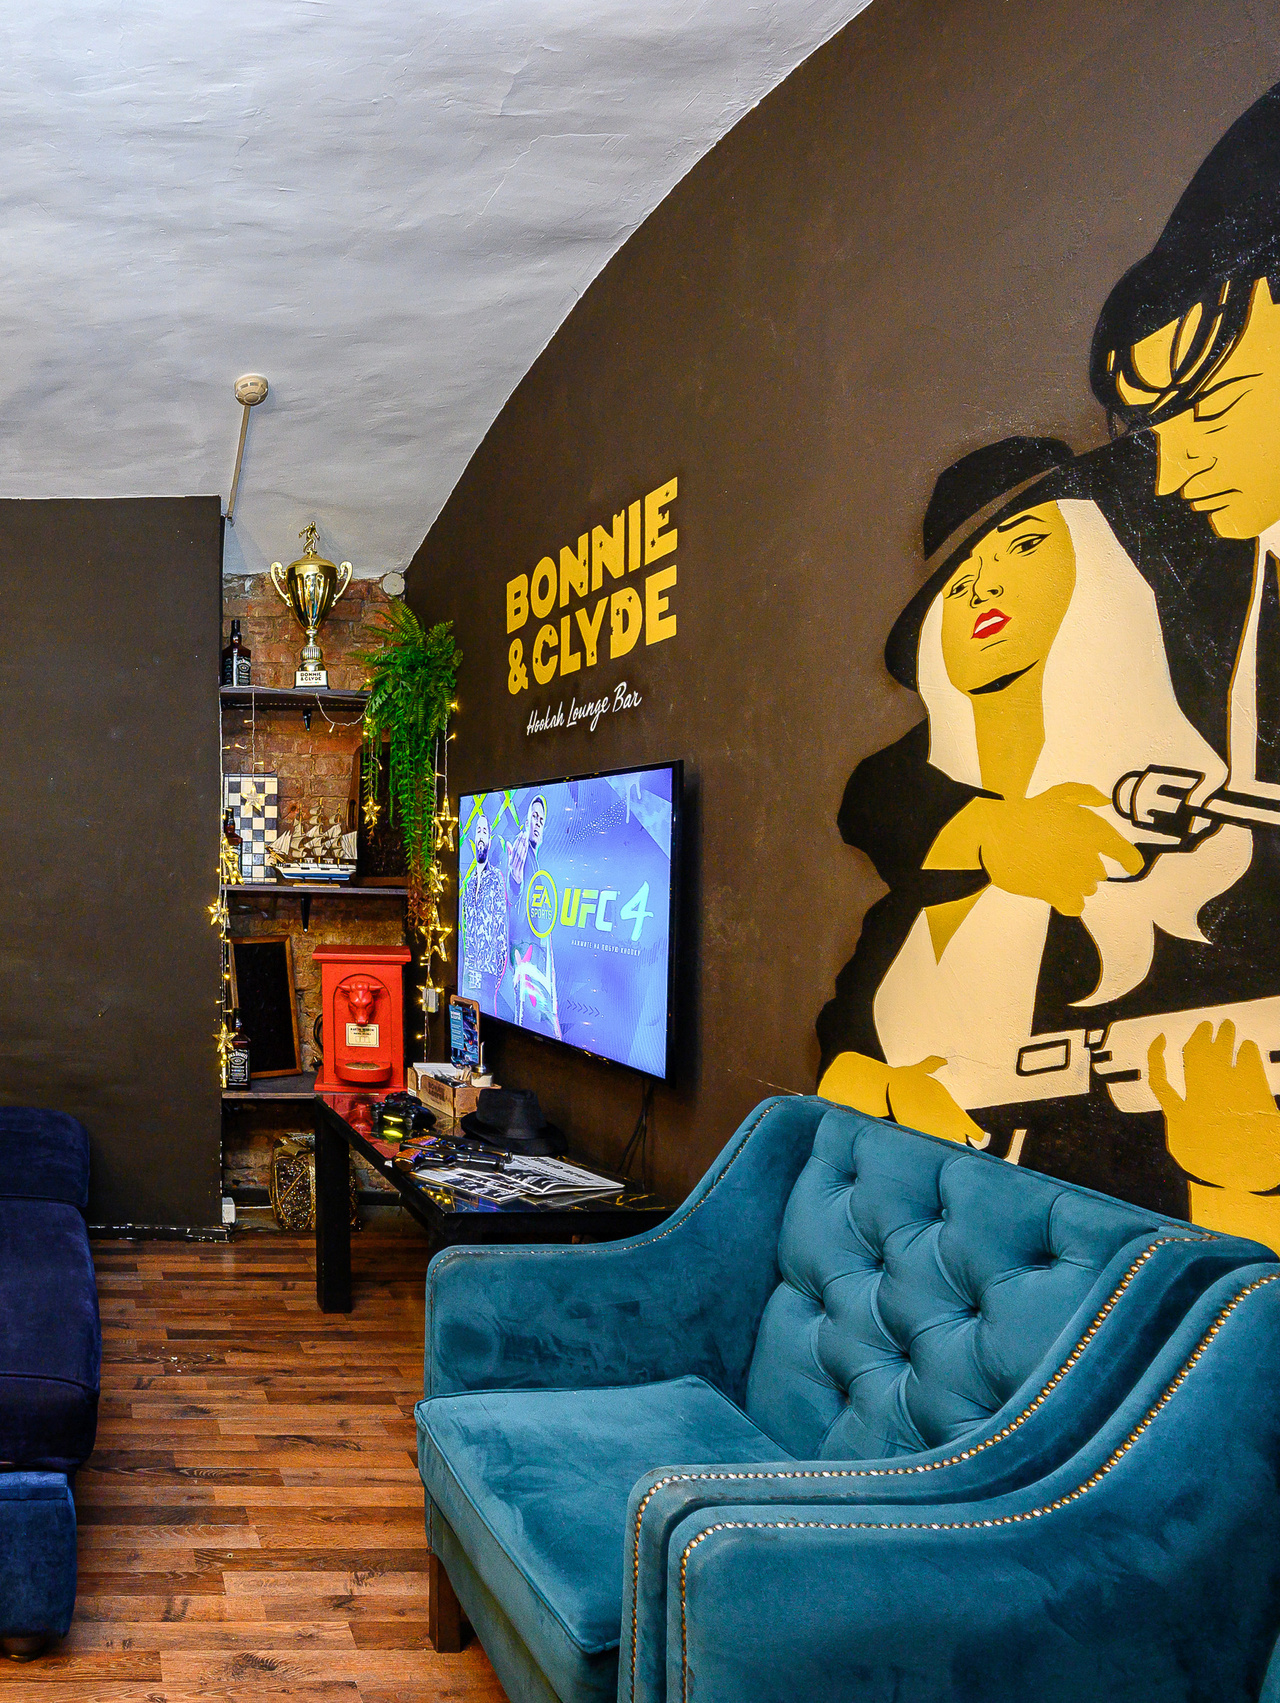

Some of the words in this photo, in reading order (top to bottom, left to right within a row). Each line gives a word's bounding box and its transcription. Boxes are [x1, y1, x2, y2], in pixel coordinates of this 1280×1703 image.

[506, 476, 678, 634] BONNIE
[508, 638, 529, 695] &
[532, 564, 677, 685] CLYDE
[526, 701, 565, 736] Hookah
[566, 697, 611, 732] Lounge
[612, 681, 642, 712] Bar
[531, 908, 553, 920] SPORTS
[532, 885, 552, 908] EA
[560, 888, 618, 932] UFC
[620, 880, 654, 942] 4
